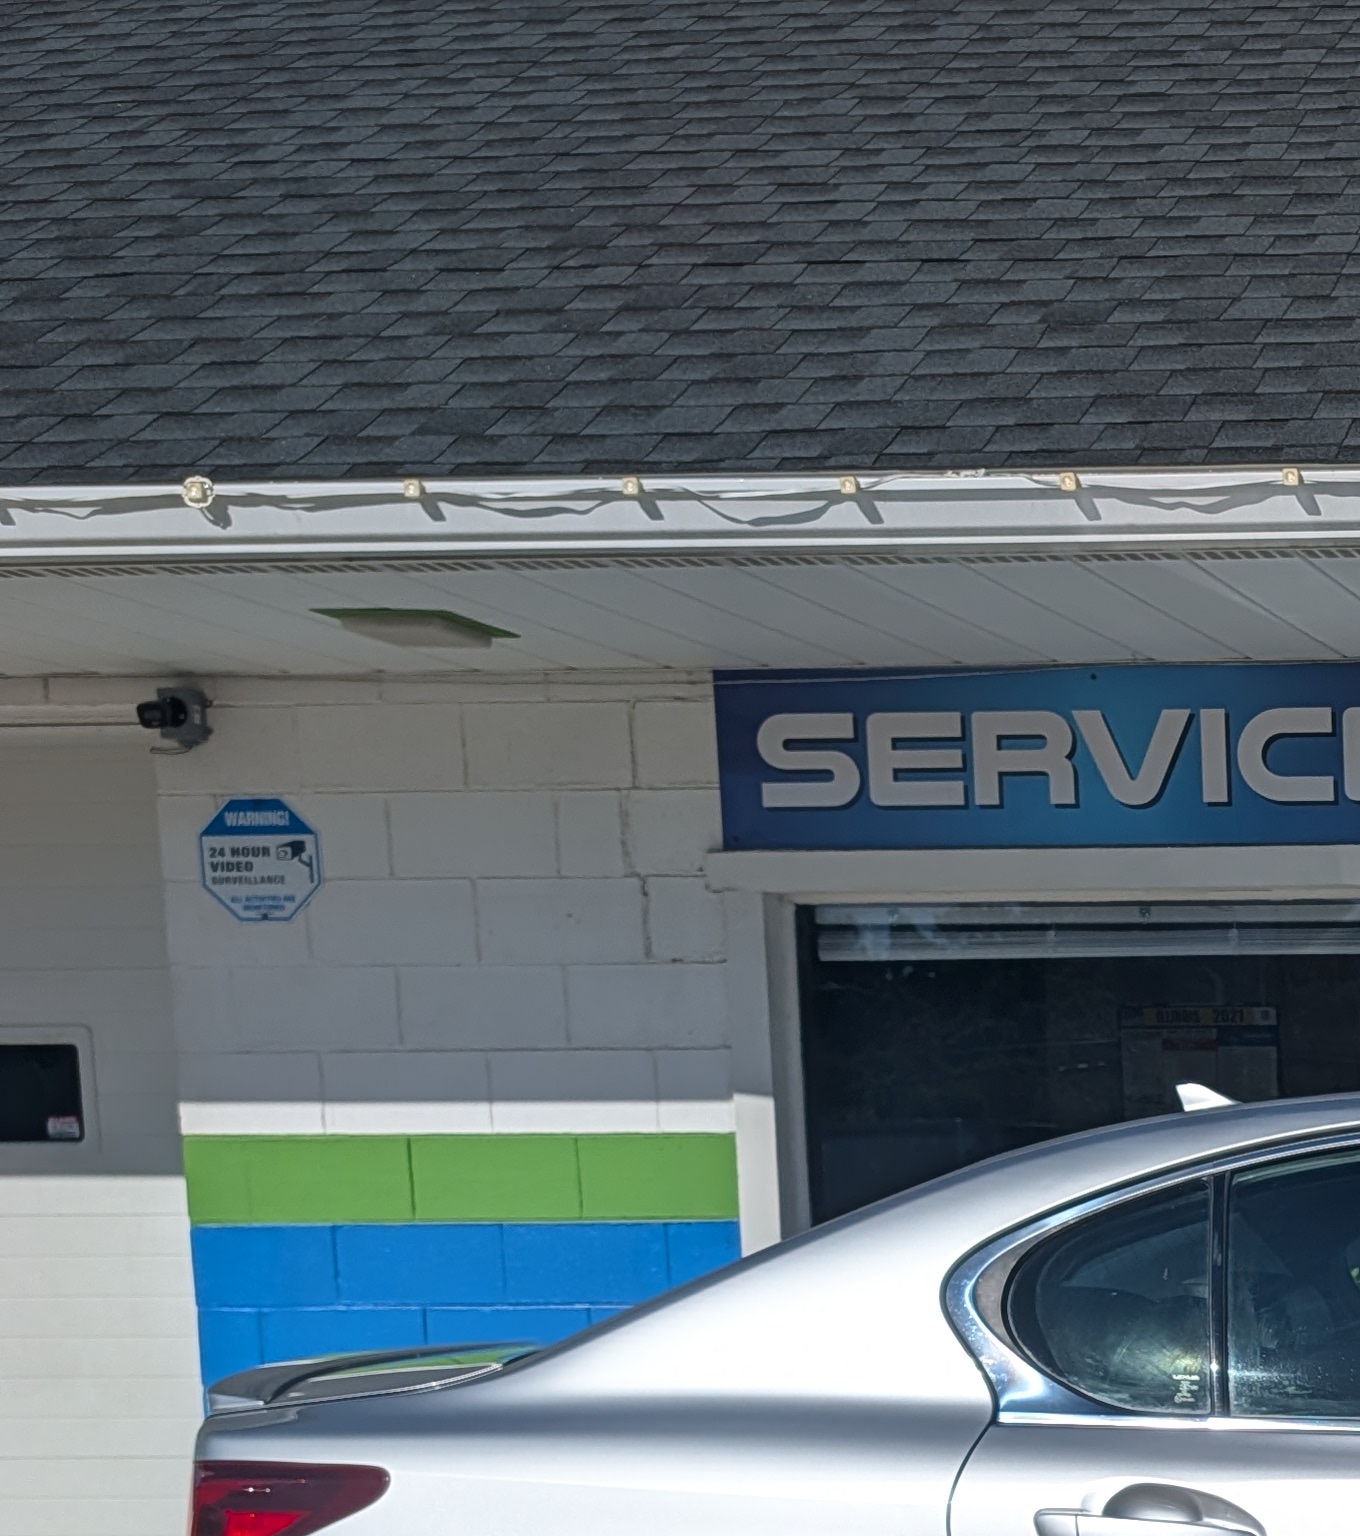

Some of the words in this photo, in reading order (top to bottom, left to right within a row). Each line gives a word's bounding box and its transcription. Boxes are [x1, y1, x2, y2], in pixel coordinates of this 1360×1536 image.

[224, 810, 290, 827] WARNING!
[208, 847, 226, 859] 24
[230, 846, 271, 858] HOUR
[210, 861, 254, 873] VIDEO
[211, 875, 286, 885] SURVEILLANCE
